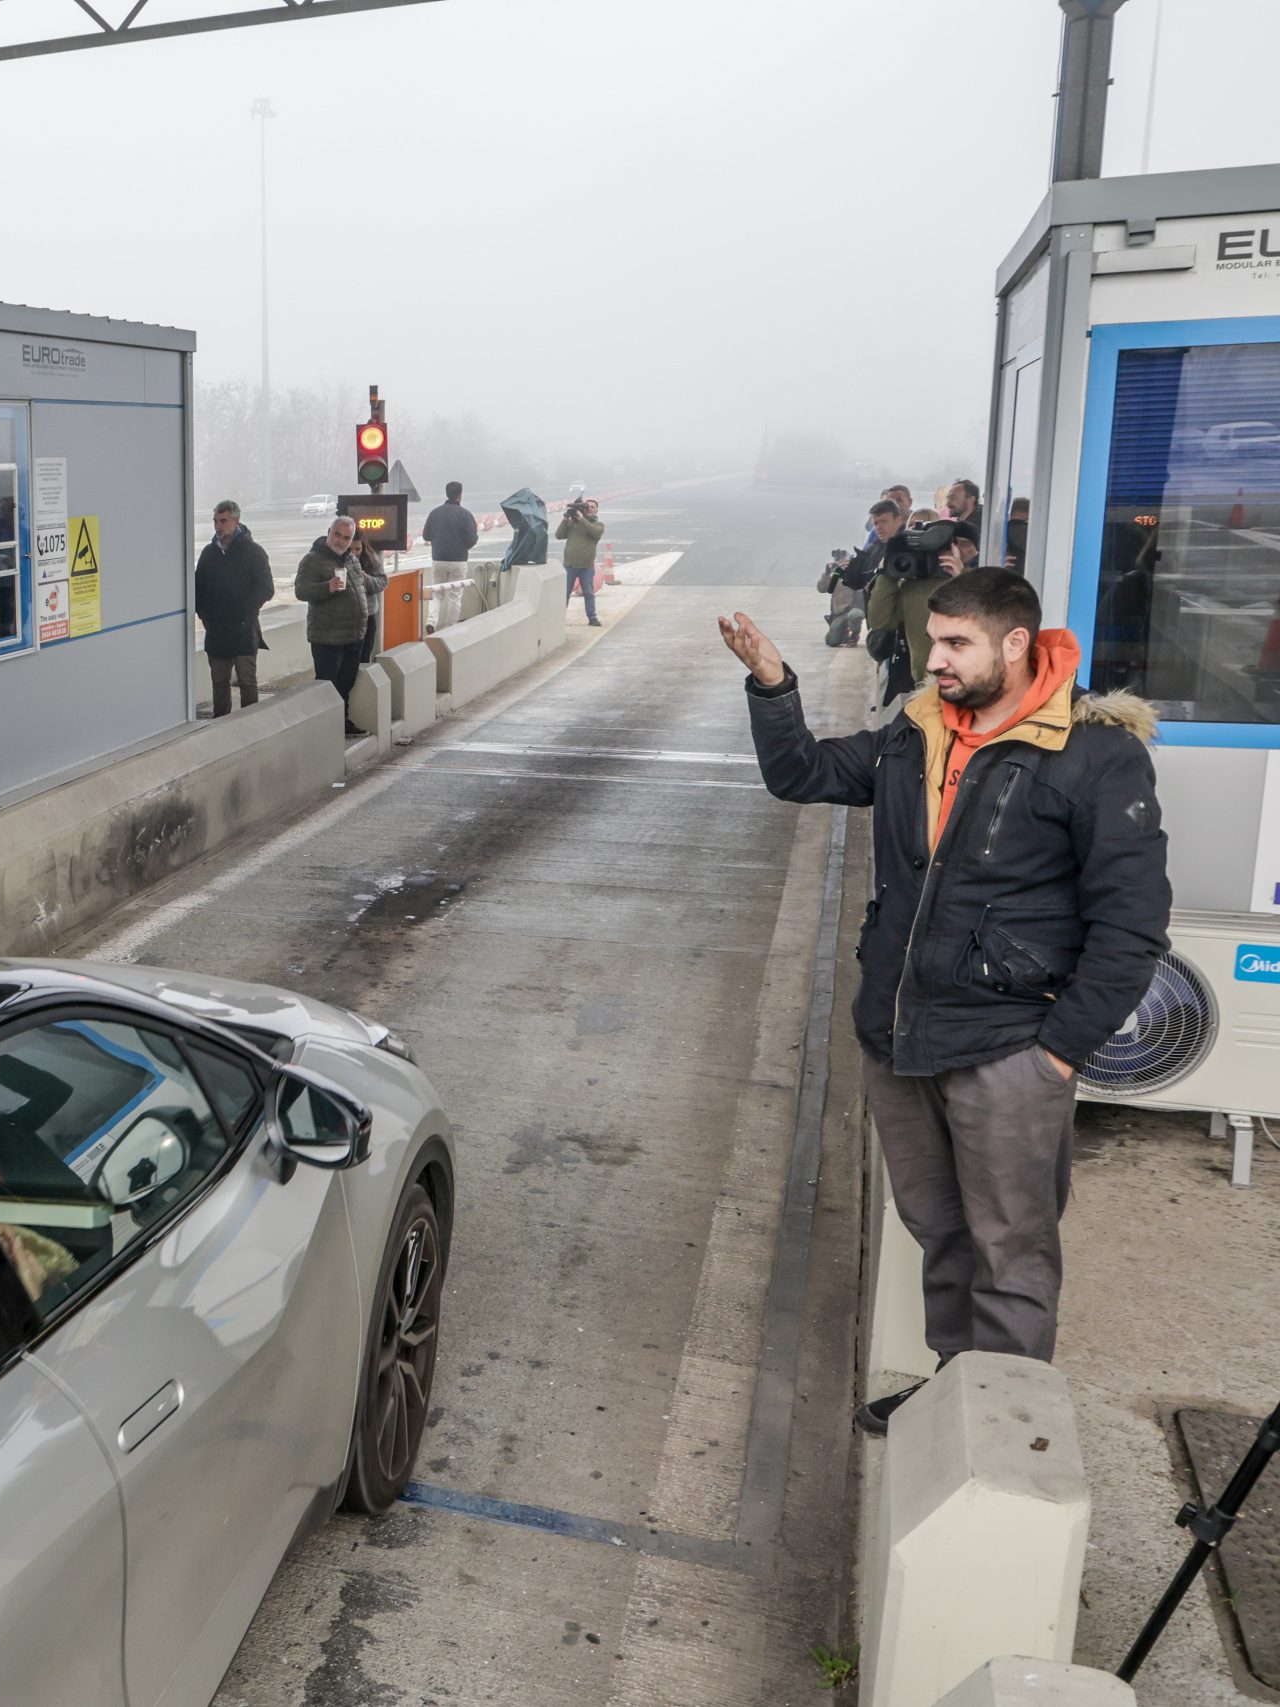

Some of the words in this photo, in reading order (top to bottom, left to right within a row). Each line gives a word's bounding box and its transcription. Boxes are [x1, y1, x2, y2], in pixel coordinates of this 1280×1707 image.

[1217, 229, 1280, 261] EU
[1216, 260, 1272, 270] MODULAR
[359, 519, 385, 528] STOP
[44, 534, 66, 553] 1075
